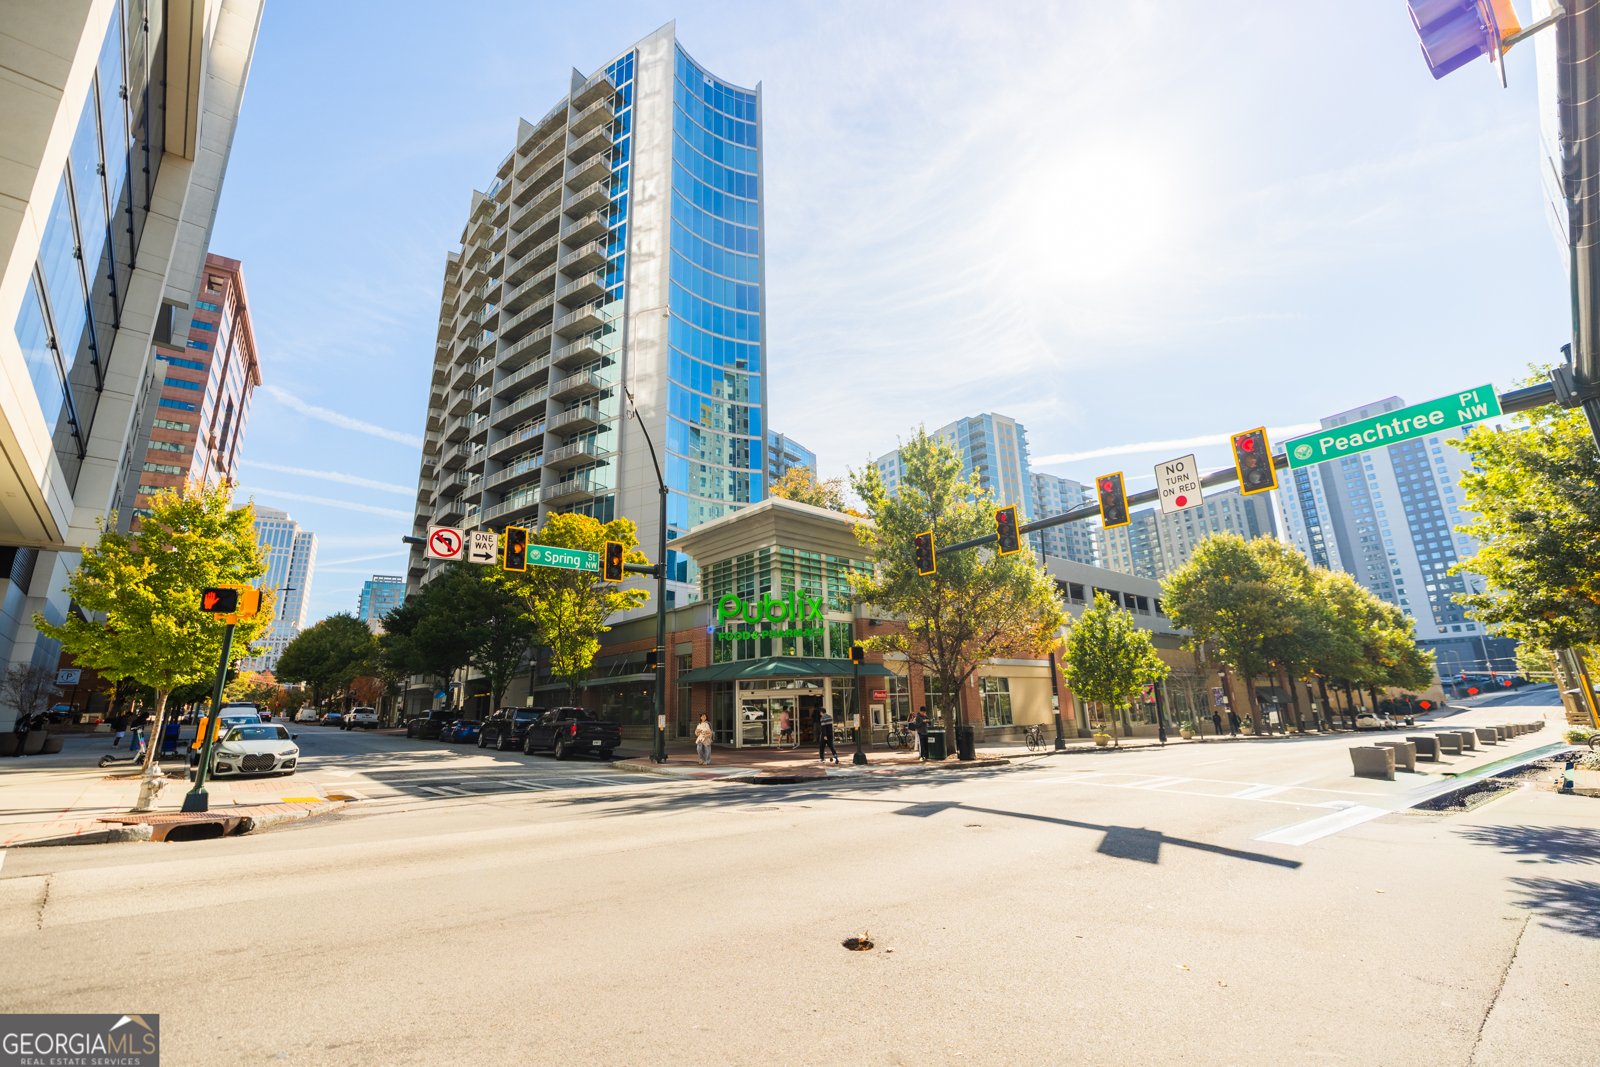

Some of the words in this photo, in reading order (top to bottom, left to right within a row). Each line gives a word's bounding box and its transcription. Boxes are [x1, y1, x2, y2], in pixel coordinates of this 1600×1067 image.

[1457, 402, 1488, 423] NW
[1319, 410, 1445, 455] Peachtree
[1165, 462, 1184, 475] NO
[1166, 473, 1189, 485] TURN
[1163, 488, 1175, 497] ON
[1179, 482, 1196, 493] RED
[475, 533, 494, 542] ONE
[475, 541, 494, 551] WAY
[544, 552, 581, 569] Spring
[587, 553, 596, 561] St
[585, 561, 598, 569] NW
[717, 589, 824, 626] Publix
[718, 631, 751, 641] FOOD
[762, 628, 825, 639] PHARMACY
